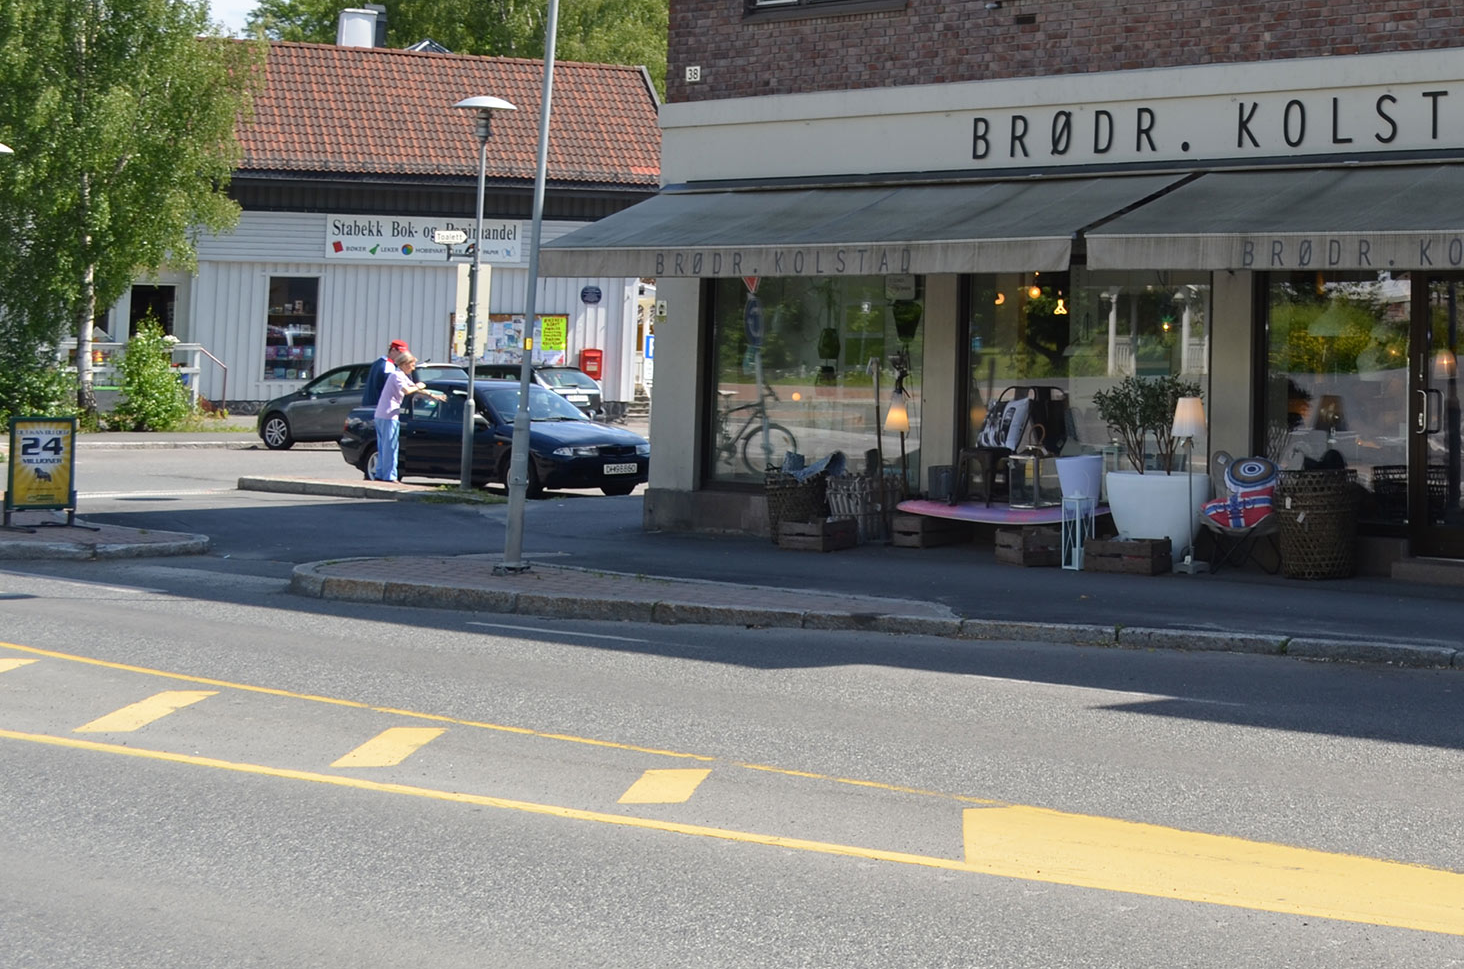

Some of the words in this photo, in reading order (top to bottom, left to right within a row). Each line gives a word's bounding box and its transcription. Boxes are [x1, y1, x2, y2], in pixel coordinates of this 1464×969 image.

[687, 68, 698, 80] 38
[972, 107, 1190, 160] BRØDR.
[332, 219, 384, 237] Stabekk
[391, 220, 418, 238] Bok-
[446, 223, 517, 242] Ppirandel
[437, 233, 463, 241] Toalett
[655, 251, 758, 275] BRØDR.
[775, 249, 912, 274] KOLSTAD
[1241, 239, 1395, 267] BRØDR.
[22, 437, 63, 455] 24
